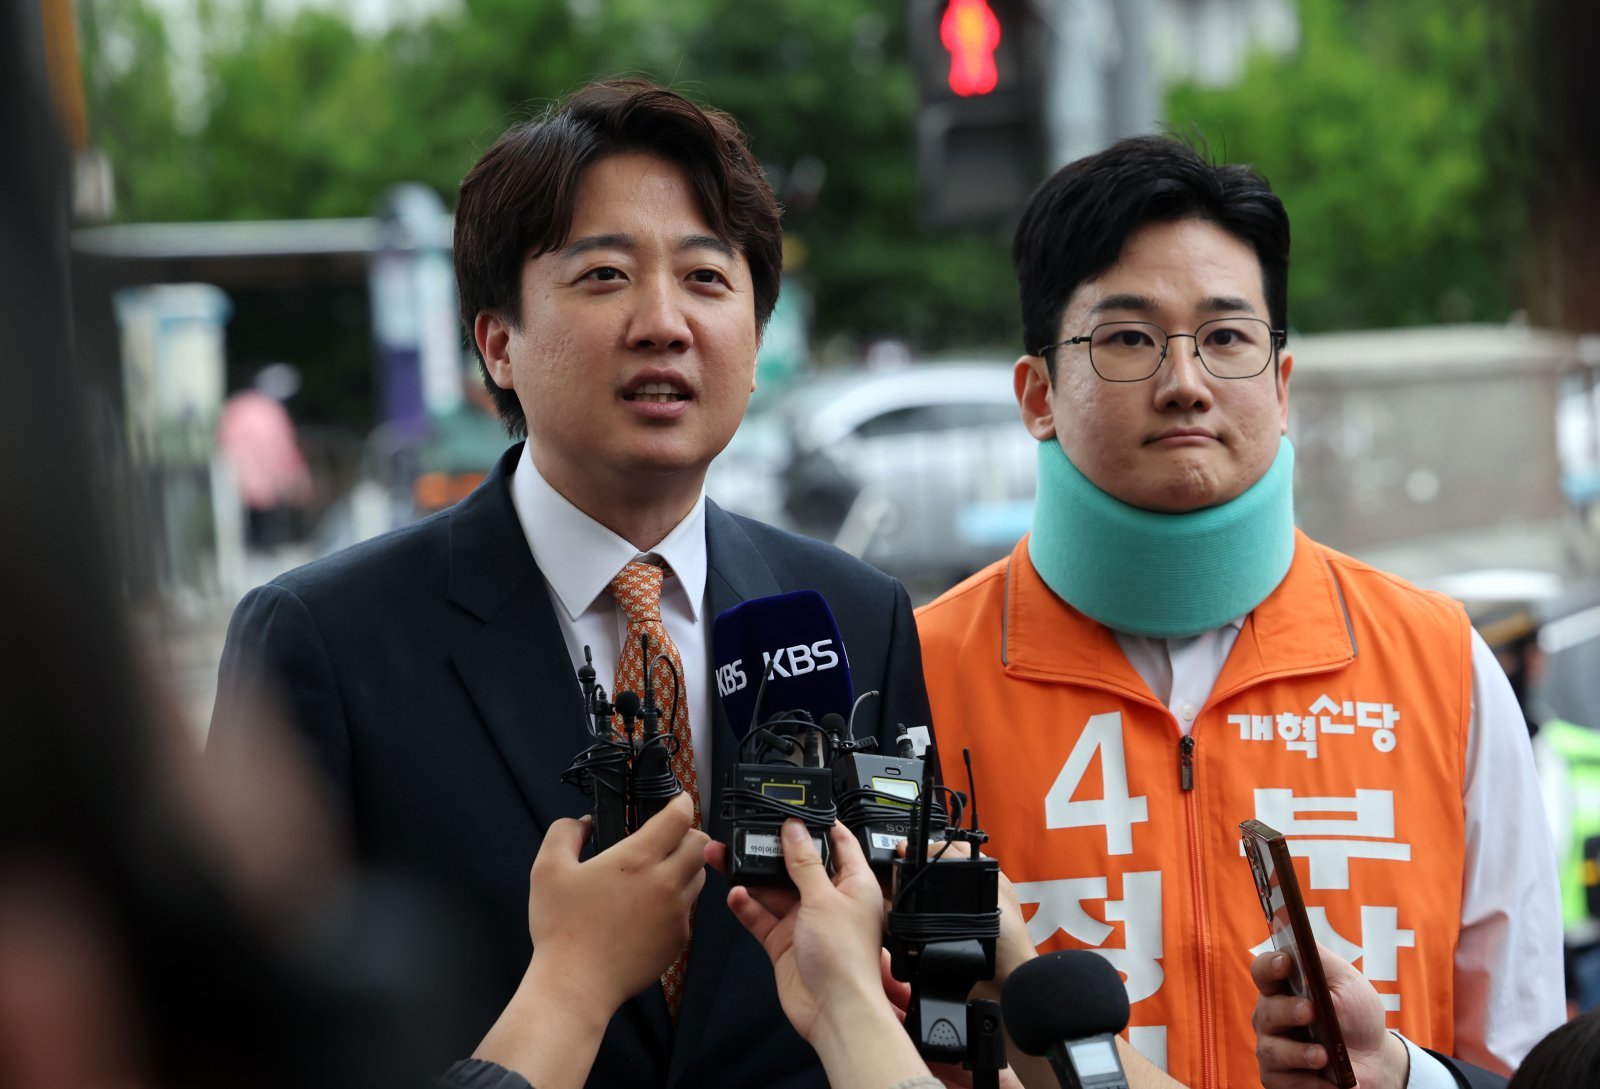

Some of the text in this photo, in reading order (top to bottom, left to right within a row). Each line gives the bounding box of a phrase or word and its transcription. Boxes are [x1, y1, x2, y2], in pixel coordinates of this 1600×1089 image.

[715, 659, 748, 698] KBS
[762, 639, 839, 681] KBS
[1228, 694, 1400, 759] 개혁신당
[1045, 711, 1149, 856] 4
